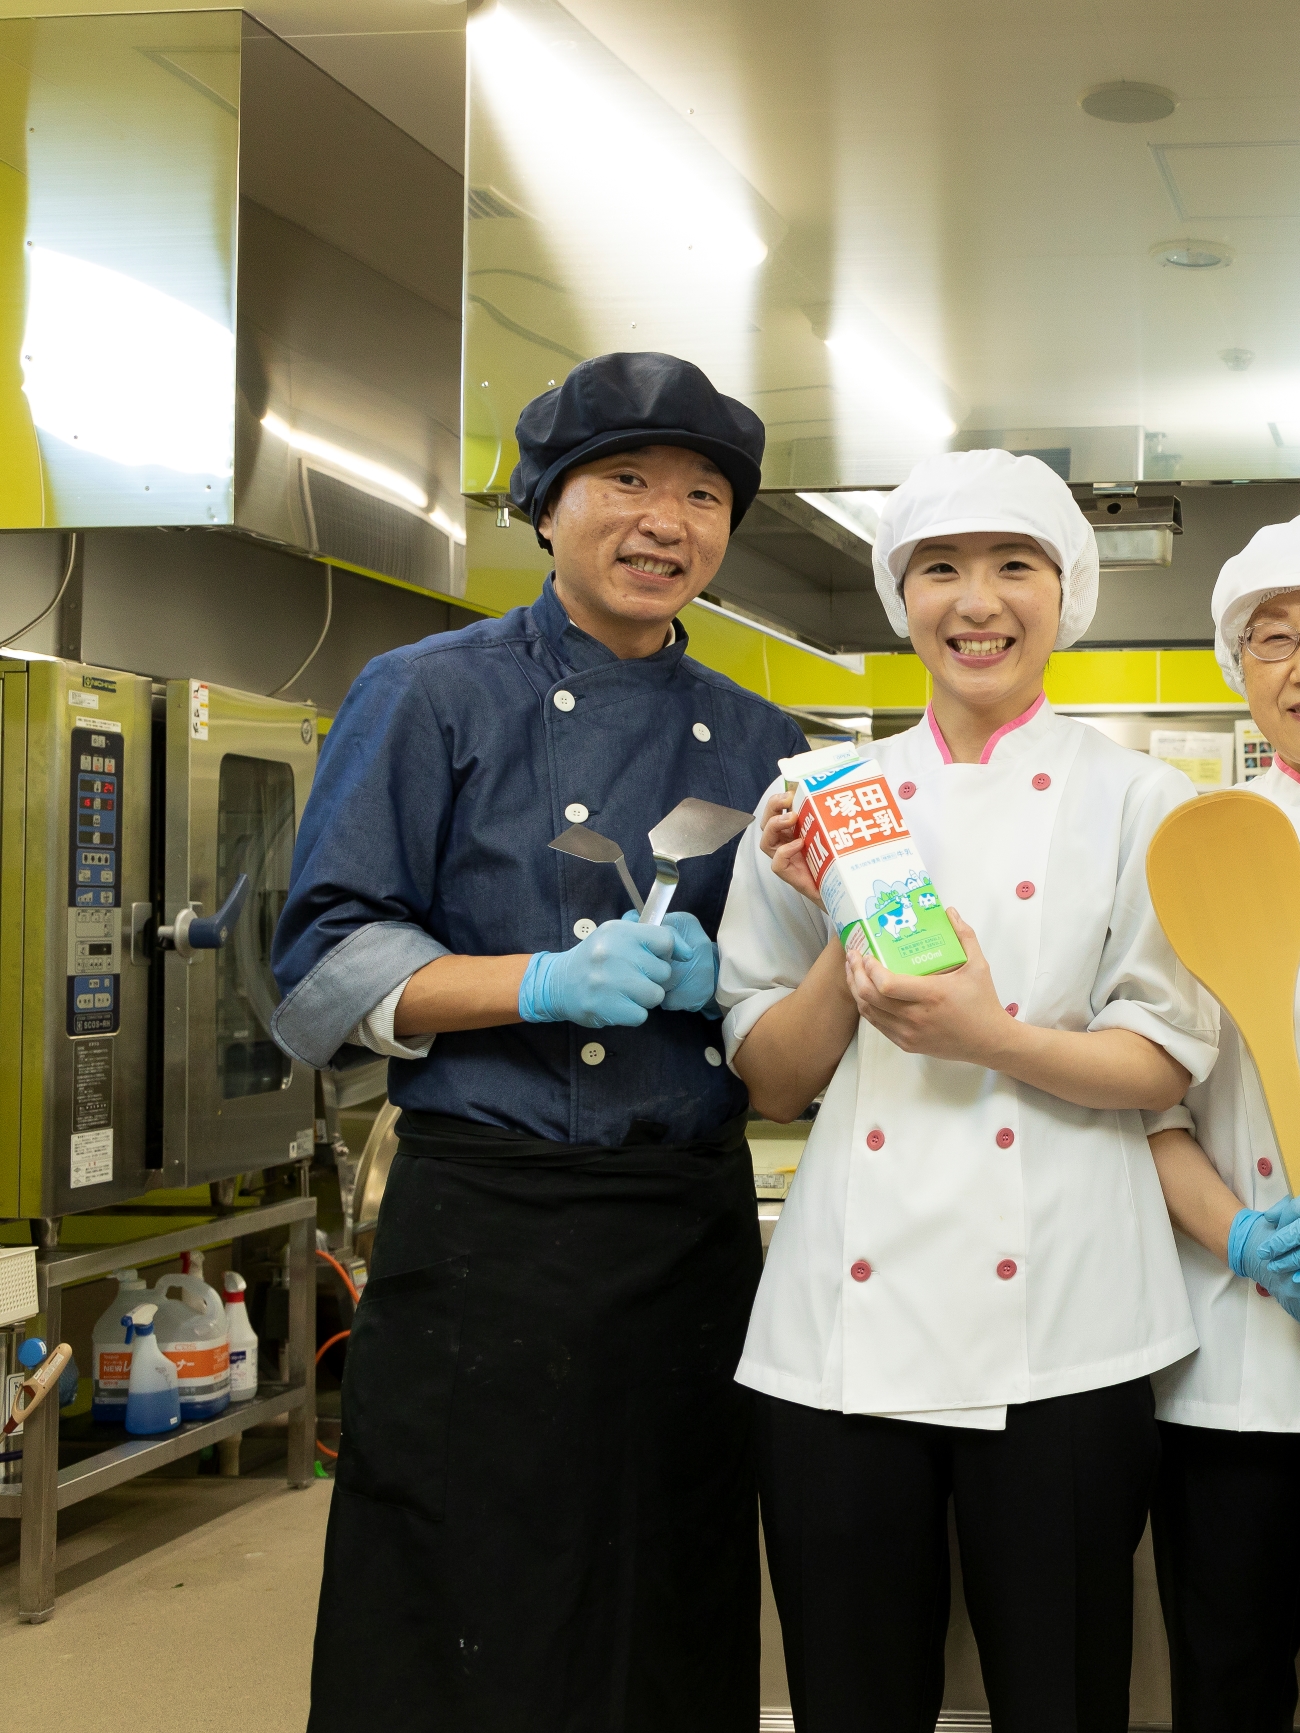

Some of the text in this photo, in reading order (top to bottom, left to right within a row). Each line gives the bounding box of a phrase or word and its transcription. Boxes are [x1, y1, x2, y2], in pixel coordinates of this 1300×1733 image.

[825, 783, 889, 818] 塚田
[806, 830, 830, 883] MILK
[911, 949, 943, 966] 1000ml
